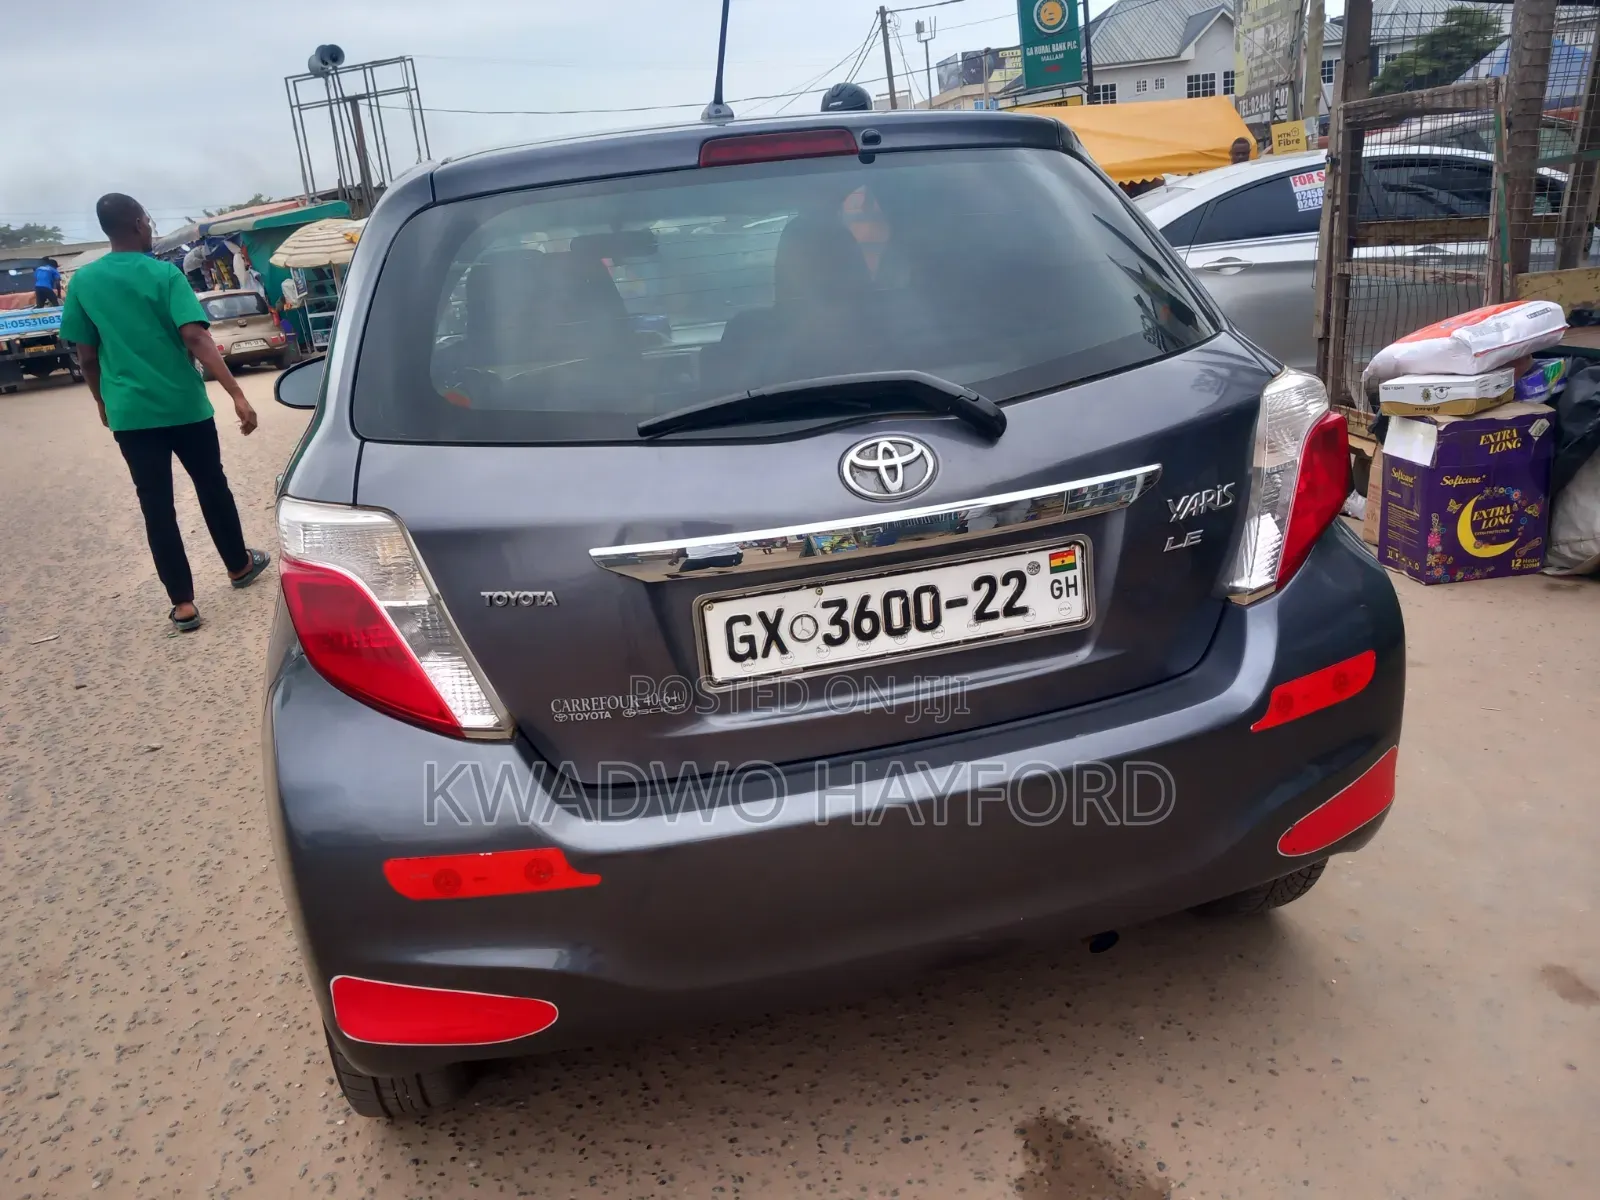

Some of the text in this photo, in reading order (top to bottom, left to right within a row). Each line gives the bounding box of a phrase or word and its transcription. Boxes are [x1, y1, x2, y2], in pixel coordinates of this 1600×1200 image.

[1034, 44, 1051, 55] RURAL
[1052, 42, 1066, 53] BANK
[1041, 53, 1064, 62] MALLAM
[1278, 138, 1300, 147] Fibre
[1292, 173, 1315, 187] FOR
[1296, 187, 1325, 200] 02458
[1479, 428, 1518, 446] EXTRA
[1488, 438, 1522, 454] LONG
[1440, 474, 1483, 487] Softcare
[1472, 504, 1513, 521] EXTRA
[1481, 513, 1515, 530] LONG
[1163, 529, 1204, 552] LE
[1511, 558, 1522, 568] 12
[1050, 575, 1078, 600] GH
[480, 591, 558, 607] TOYOTA
[725, 570, 1029, 663] GX 3600-22
[550, 695, 639, 713] CARREFOUR
[570, 711, 612, 722] TOYOTA
